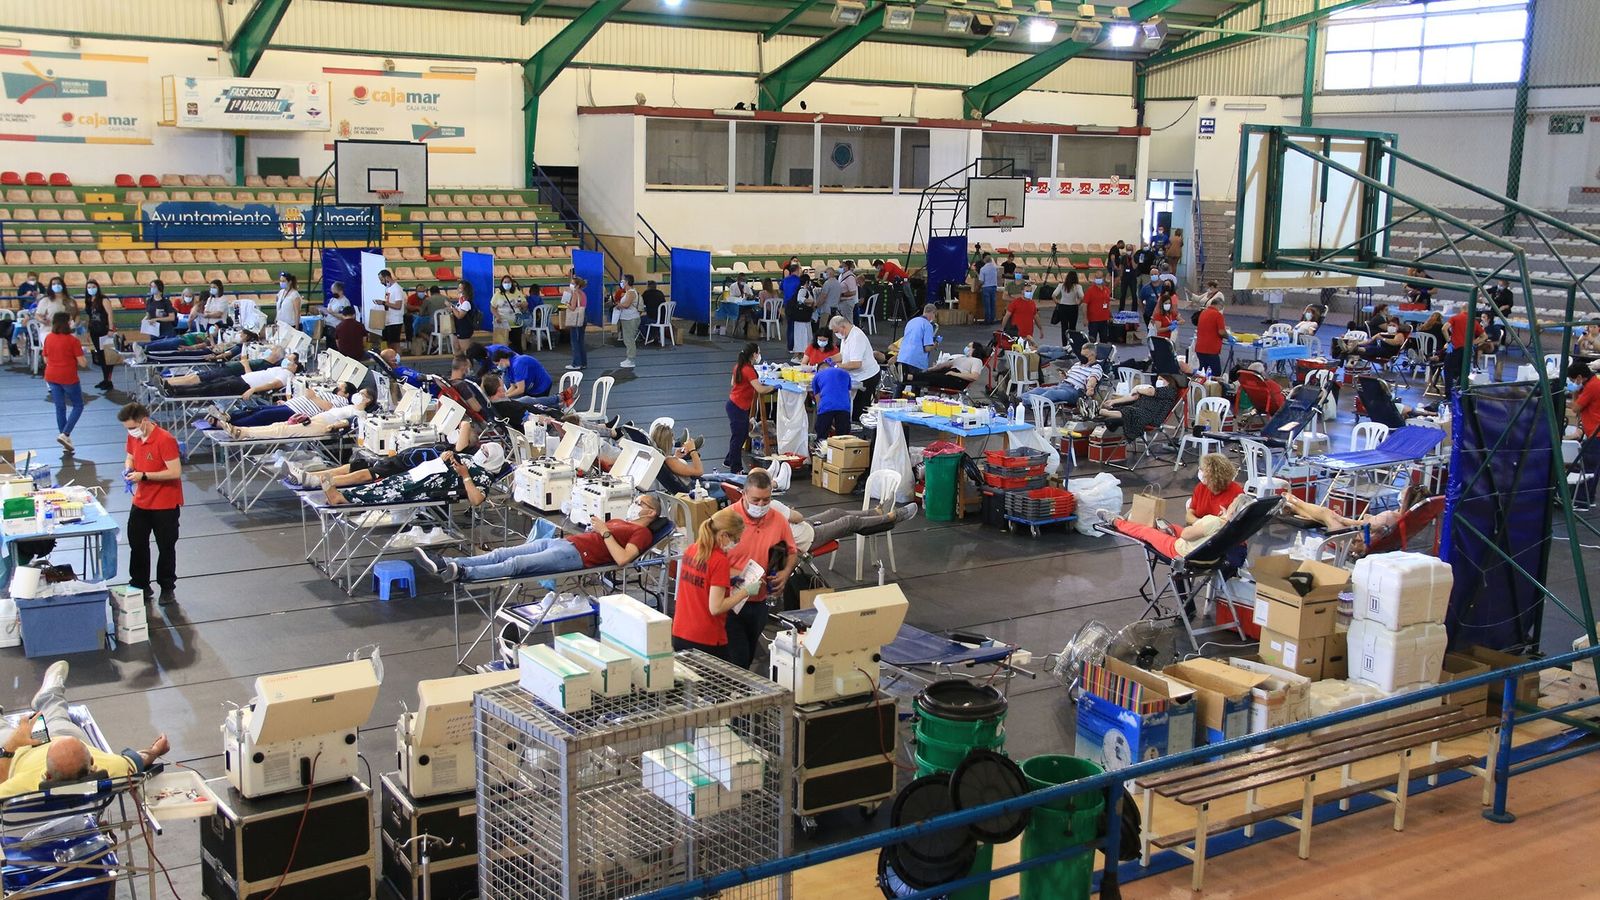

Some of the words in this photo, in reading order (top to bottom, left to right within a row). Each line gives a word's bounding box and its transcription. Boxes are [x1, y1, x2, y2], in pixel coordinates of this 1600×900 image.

[230, 88, 247, 97] FASE
[247, 89, 277, 98] ASCENSO
[371, 87, 440, 107] cajamar
[240, 100, 281, 112] NACIONAL
[78, 112, 138, 128] cajamar
[150, 211, 271, 229] Ayuntamiento
